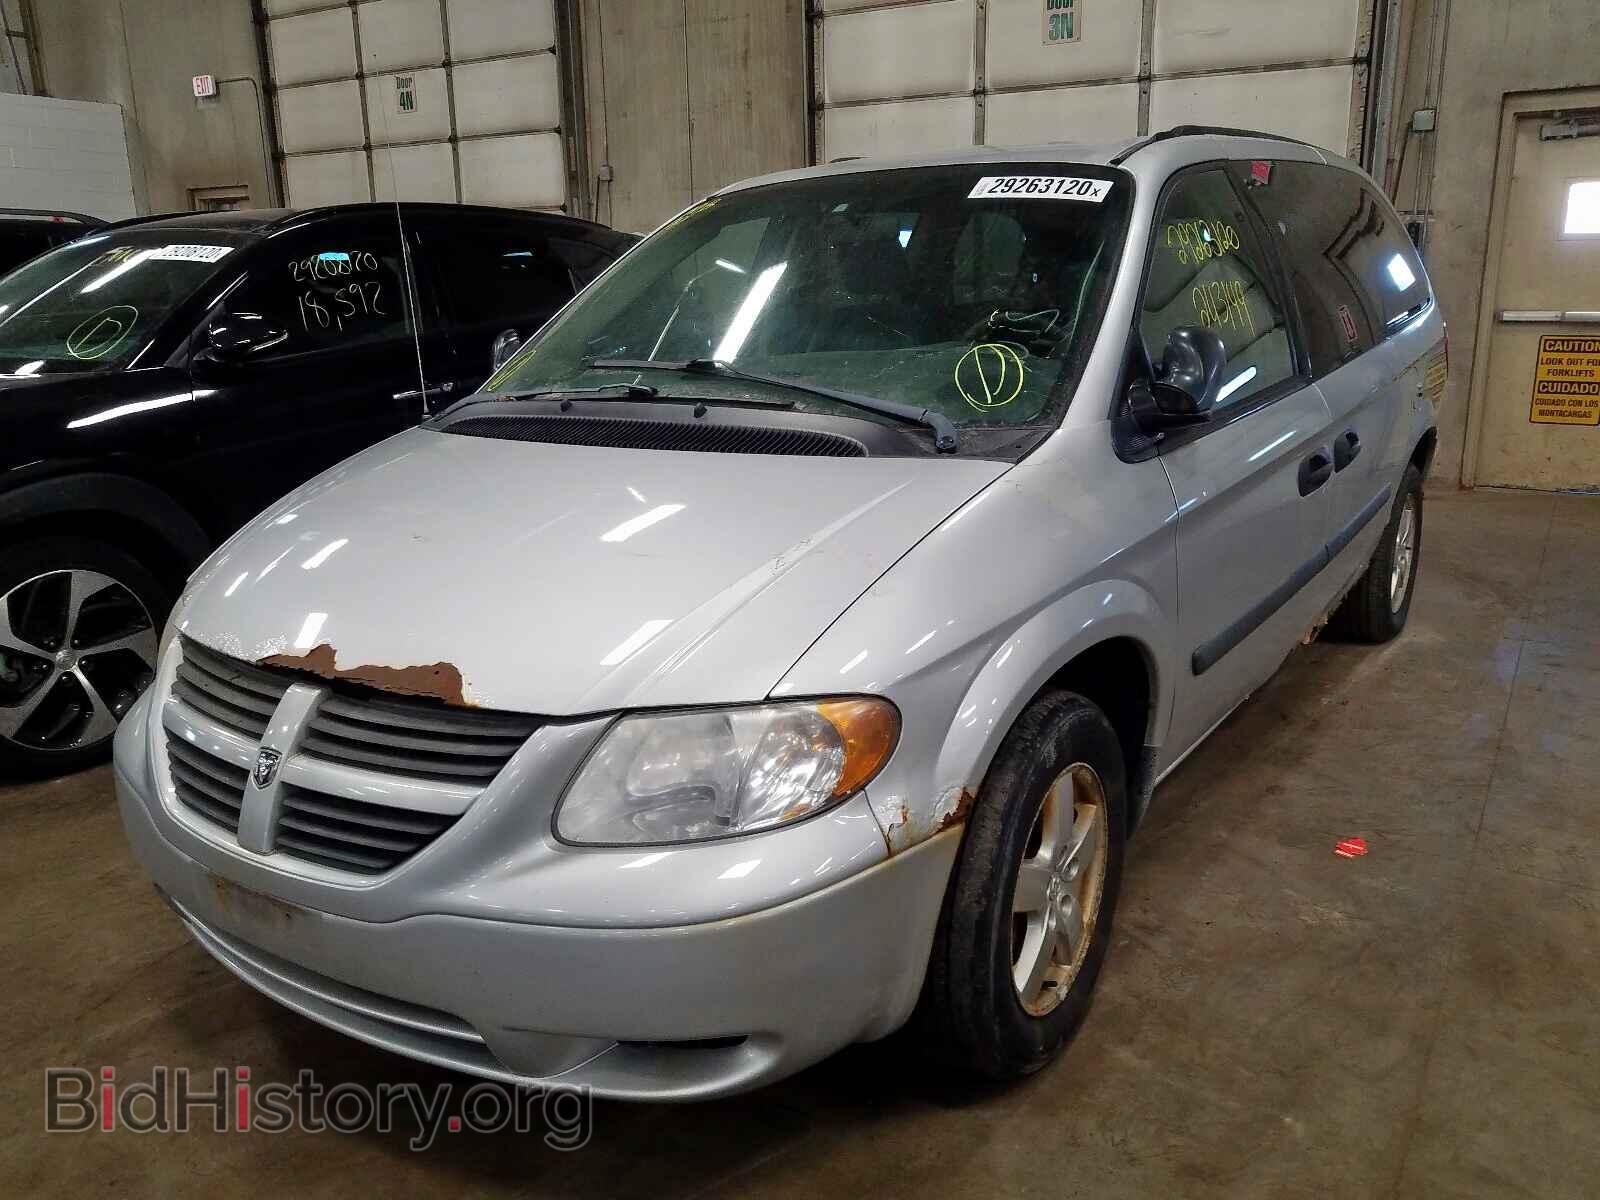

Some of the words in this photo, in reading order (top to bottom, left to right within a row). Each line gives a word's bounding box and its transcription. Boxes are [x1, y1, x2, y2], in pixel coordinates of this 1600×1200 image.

[1049, 12, 1074, 40] 3N
[196, 76, 211, 94] EXIT
[400, 91, 413, 110] 4N
[1540, 357, 1564, 366] LOOK
[1566, 358, 1585, 366] OUT
[1547, 368, 1595, 378] FORKLIFTS
[1539, 382, 1599, 394] CUIDADO
[1535, 398, 1566, 407] CUIDADO
[1568, 399, 1583, 408] CON
[1585, 400, 1599, 408] LOS
